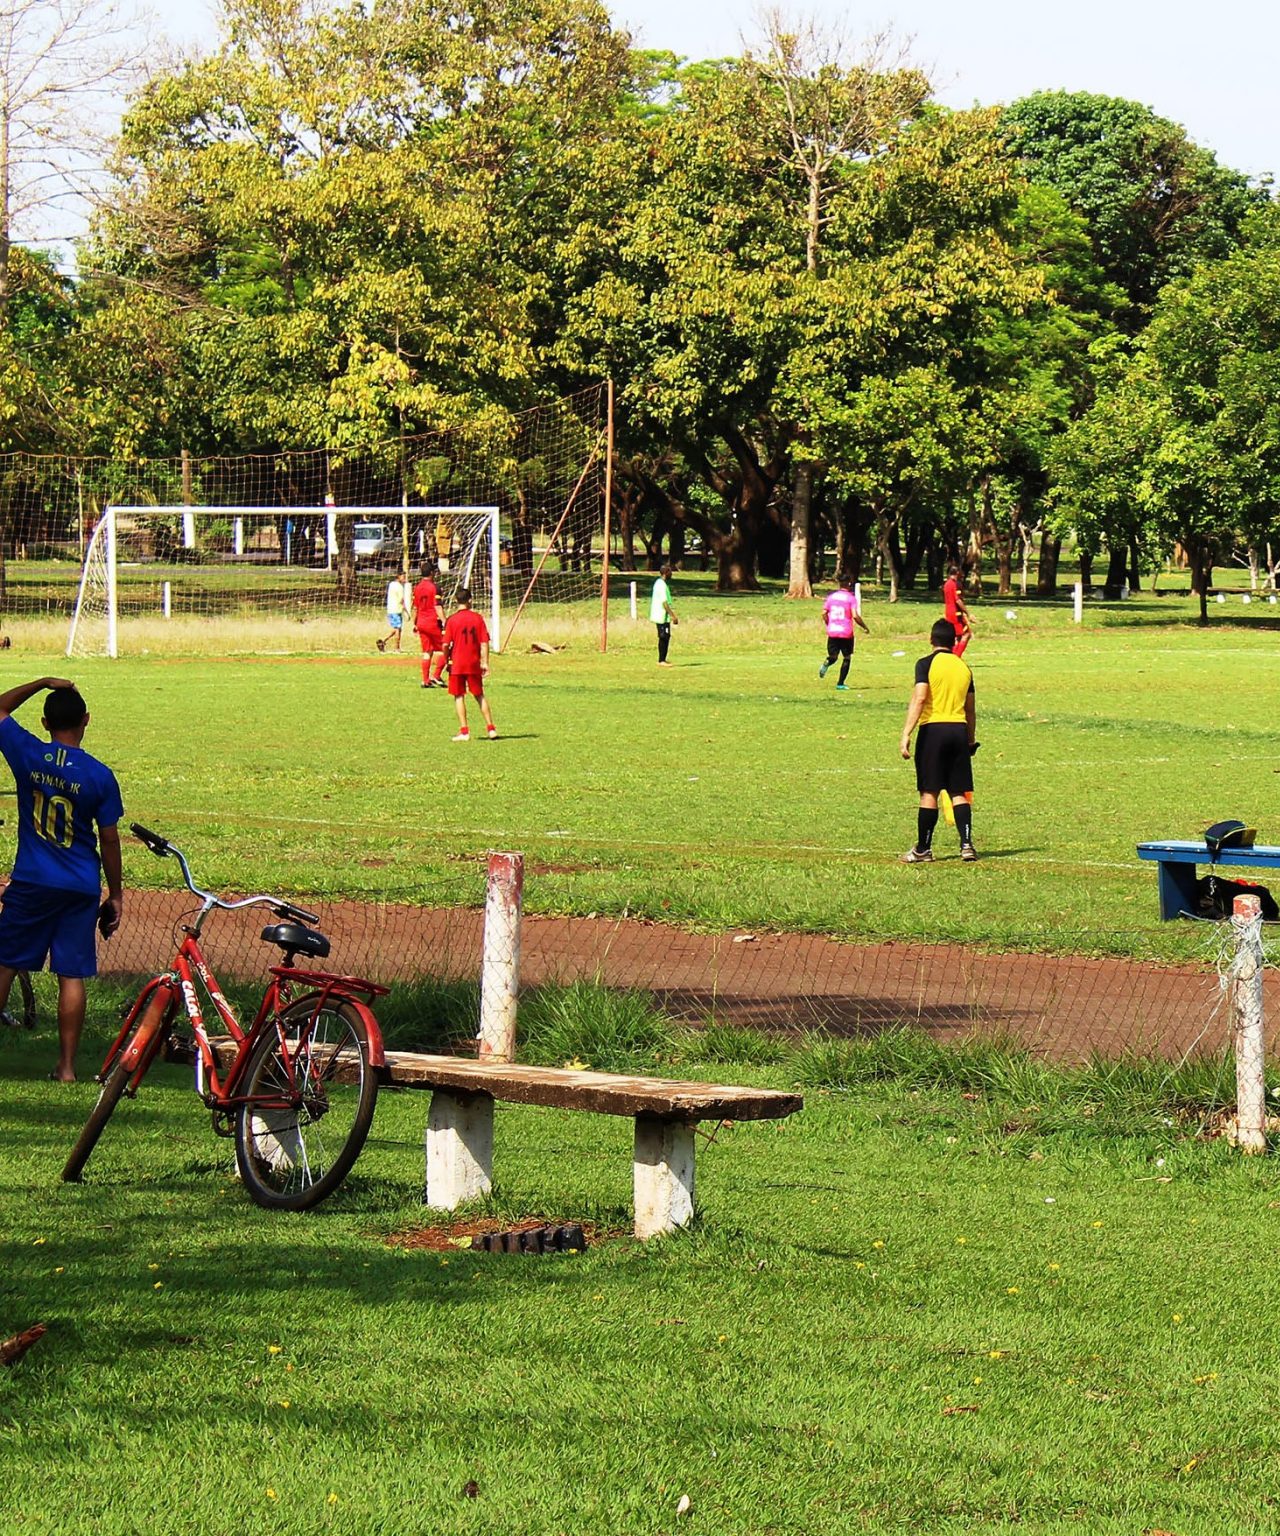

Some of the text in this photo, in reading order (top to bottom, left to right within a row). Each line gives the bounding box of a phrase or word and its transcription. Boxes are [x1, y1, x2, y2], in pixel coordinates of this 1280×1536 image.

[461, 626, 479, 645] 11
[69, 782, 81, 795] JR
[32, 790, 75, 849] 10
[182, 980, 201, 1018] CALOI
